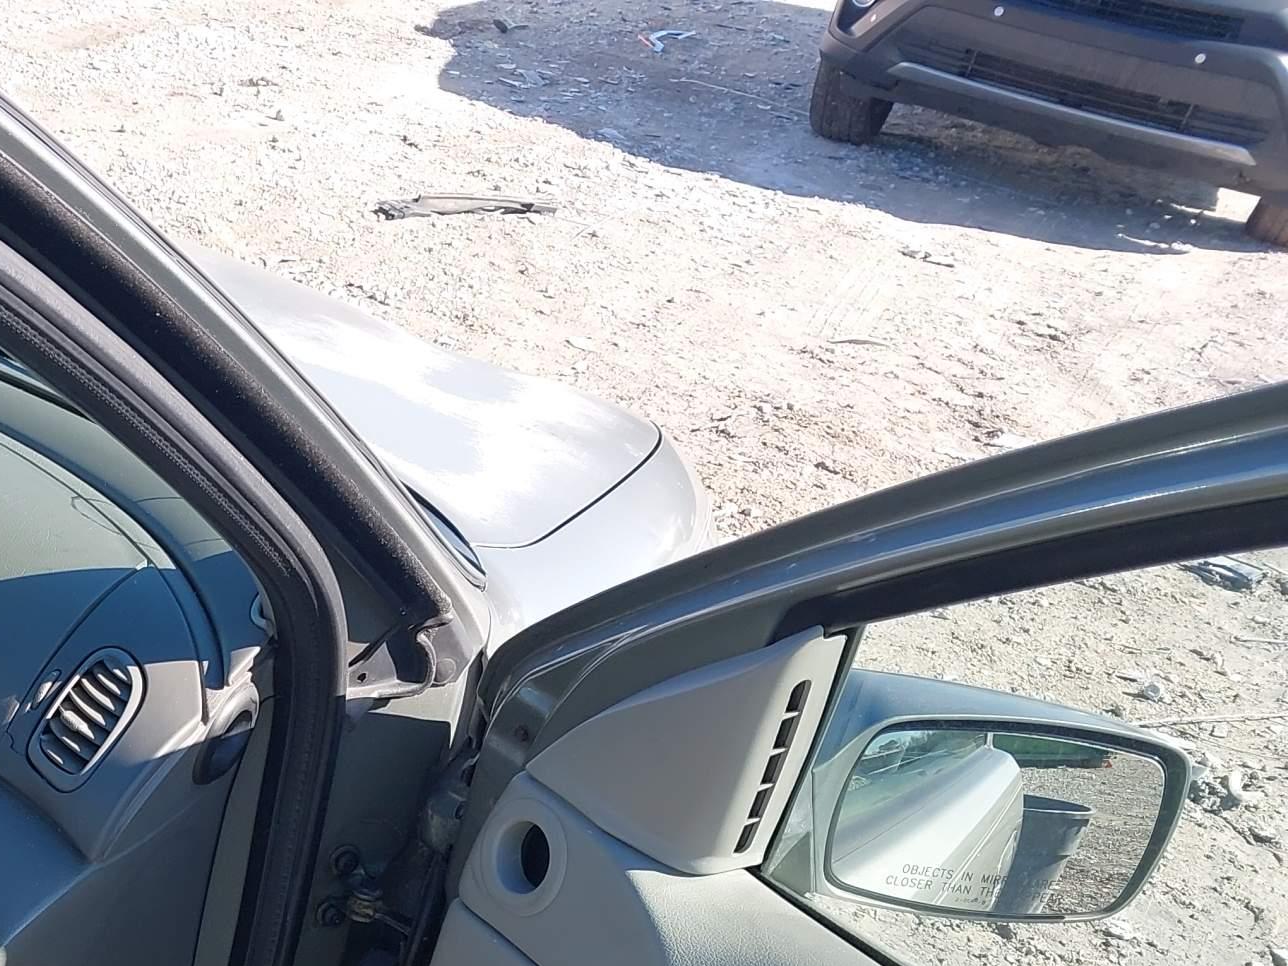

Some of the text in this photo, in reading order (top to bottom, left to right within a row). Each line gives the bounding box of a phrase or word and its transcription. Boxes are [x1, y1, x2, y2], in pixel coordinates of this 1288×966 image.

[902, 863, 954, 880] OBJECTS
[961, 871, 974, 882] IN
[885, 874, 933, 890] CLOSER
[941, 881, 972, 895] THAN
